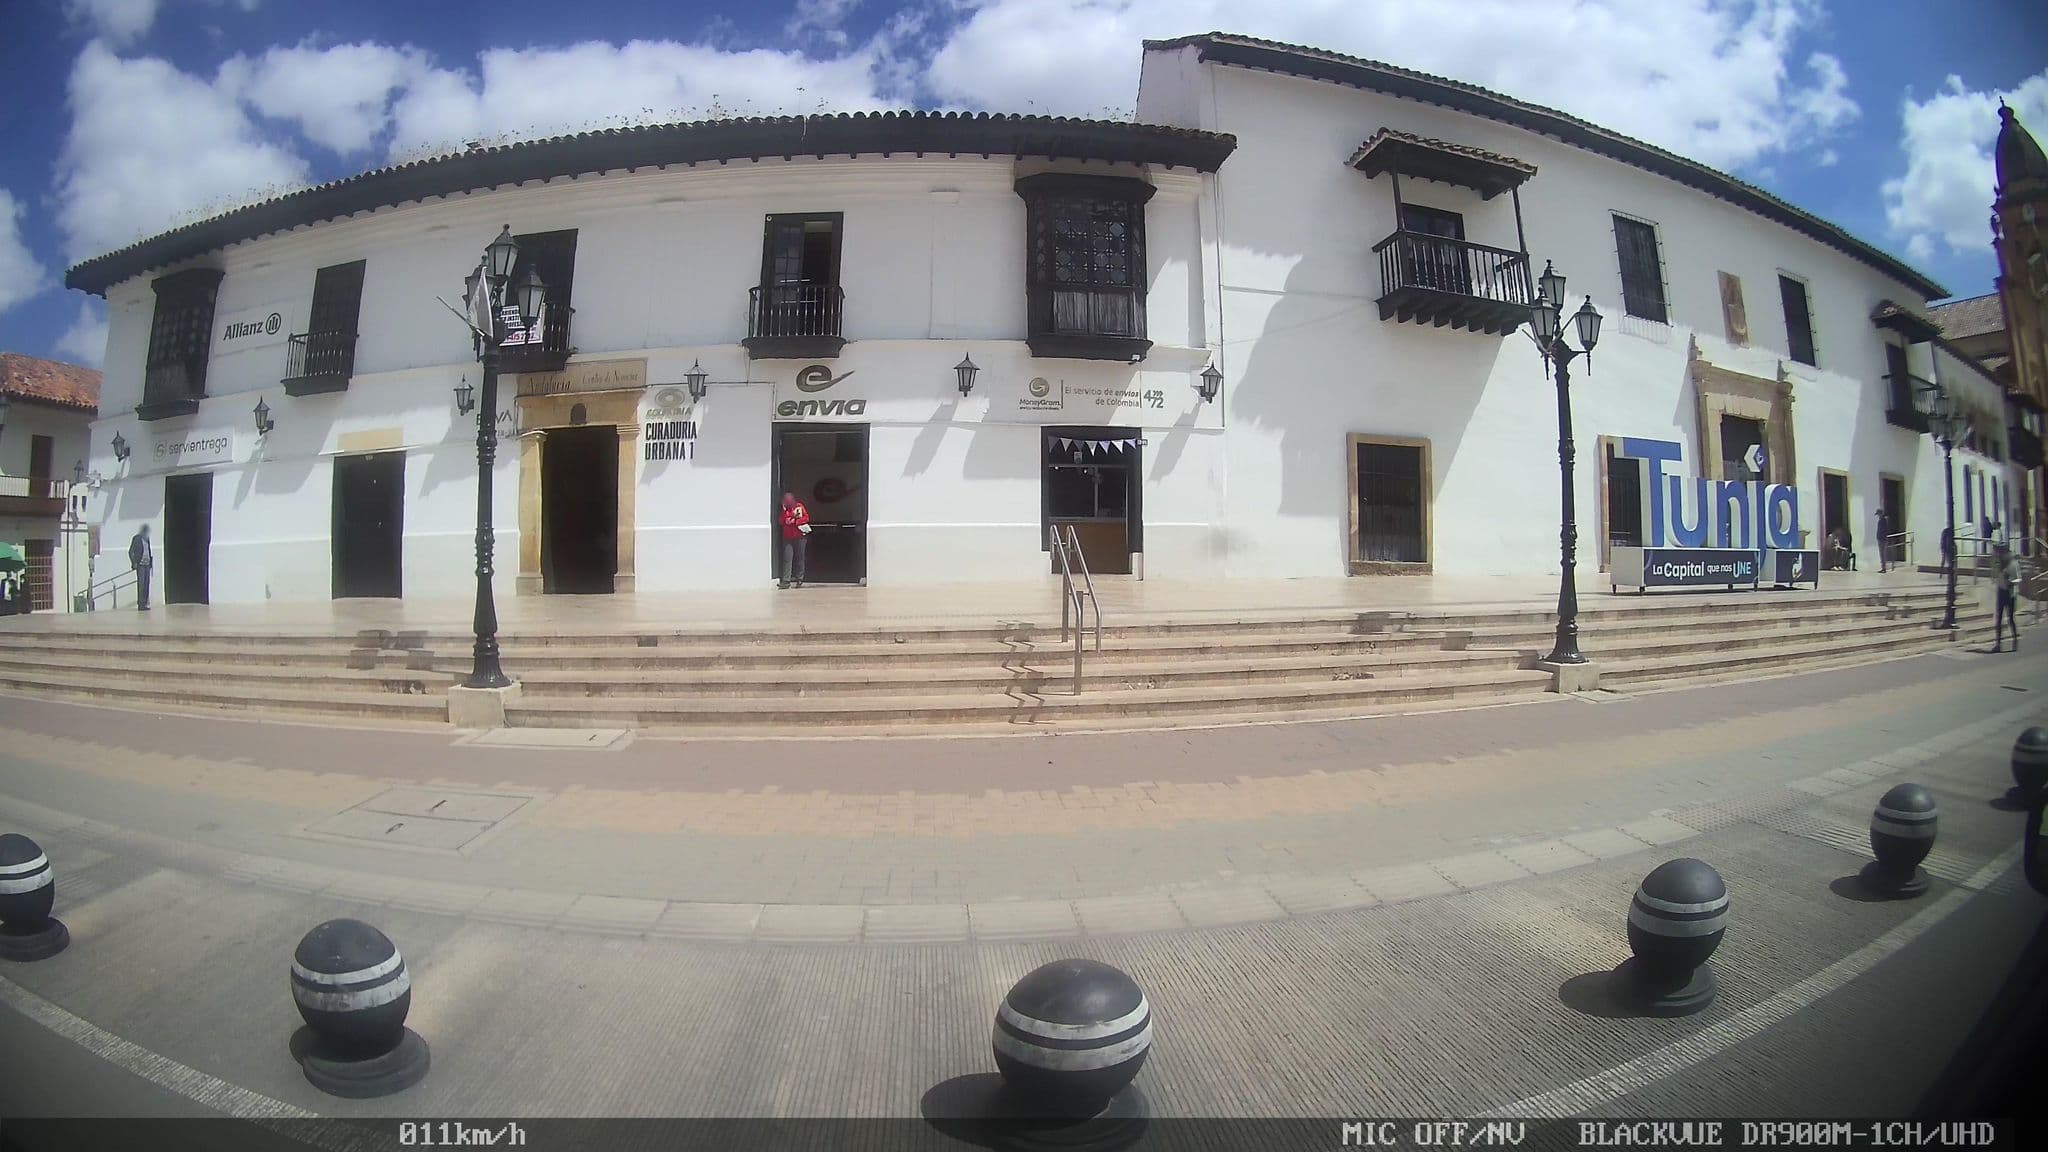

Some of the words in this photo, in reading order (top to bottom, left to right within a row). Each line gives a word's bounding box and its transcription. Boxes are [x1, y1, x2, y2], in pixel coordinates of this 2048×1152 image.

[223, 321, 264, 341] Allianz
[645, 421, 697, 440] CURADURIA
[168, 437, 228, 455] servientrega
[645, 441, 686, 460] URBANA
[690, 441, 694, 460] 1
[1622, 435, 1799, 570] Tunja
[1653, 564, 1663, 575] La
[1664, 561, 1705, 580] Capital
[1706, 564, 1720, 575] que
[1720, 564, 1733, 573] nos
[1733, 561, 1752, 578] UNE
